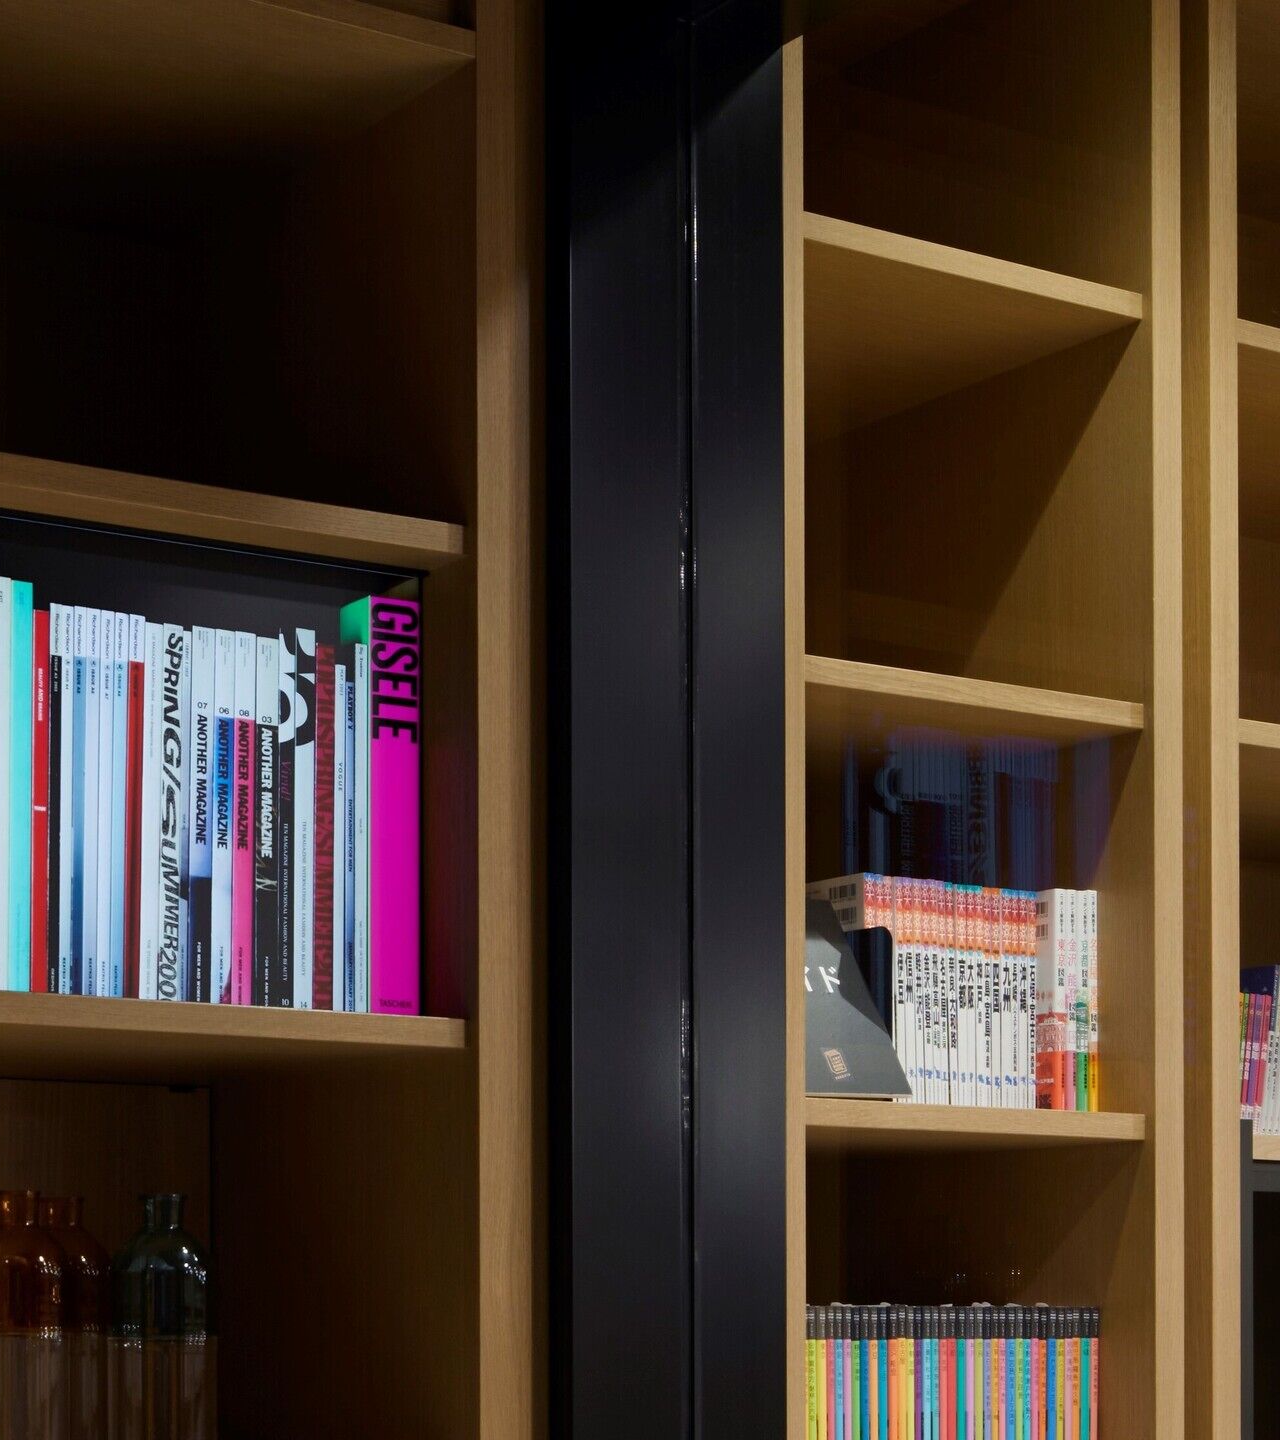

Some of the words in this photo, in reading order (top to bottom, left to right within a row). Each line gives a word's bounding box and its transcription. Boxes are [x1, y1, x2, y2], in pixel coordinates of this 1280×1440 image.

[372, 603, 418, 743] GISELE
[196, 714, 207, 775] ANOTHER
[217, 719, 229, 780] ANOTHER
[238, 721, 250, 781] ANOTHER
[261, 728, 273, 788] ANOTHER
[196, 778, 207, 845] MAGAZINE
[217, 783, 229, 849] MAGAZINE
[238, 784, 250, 850] MAGAZINE
[261, 791, 273, 858] MAGAZINE
